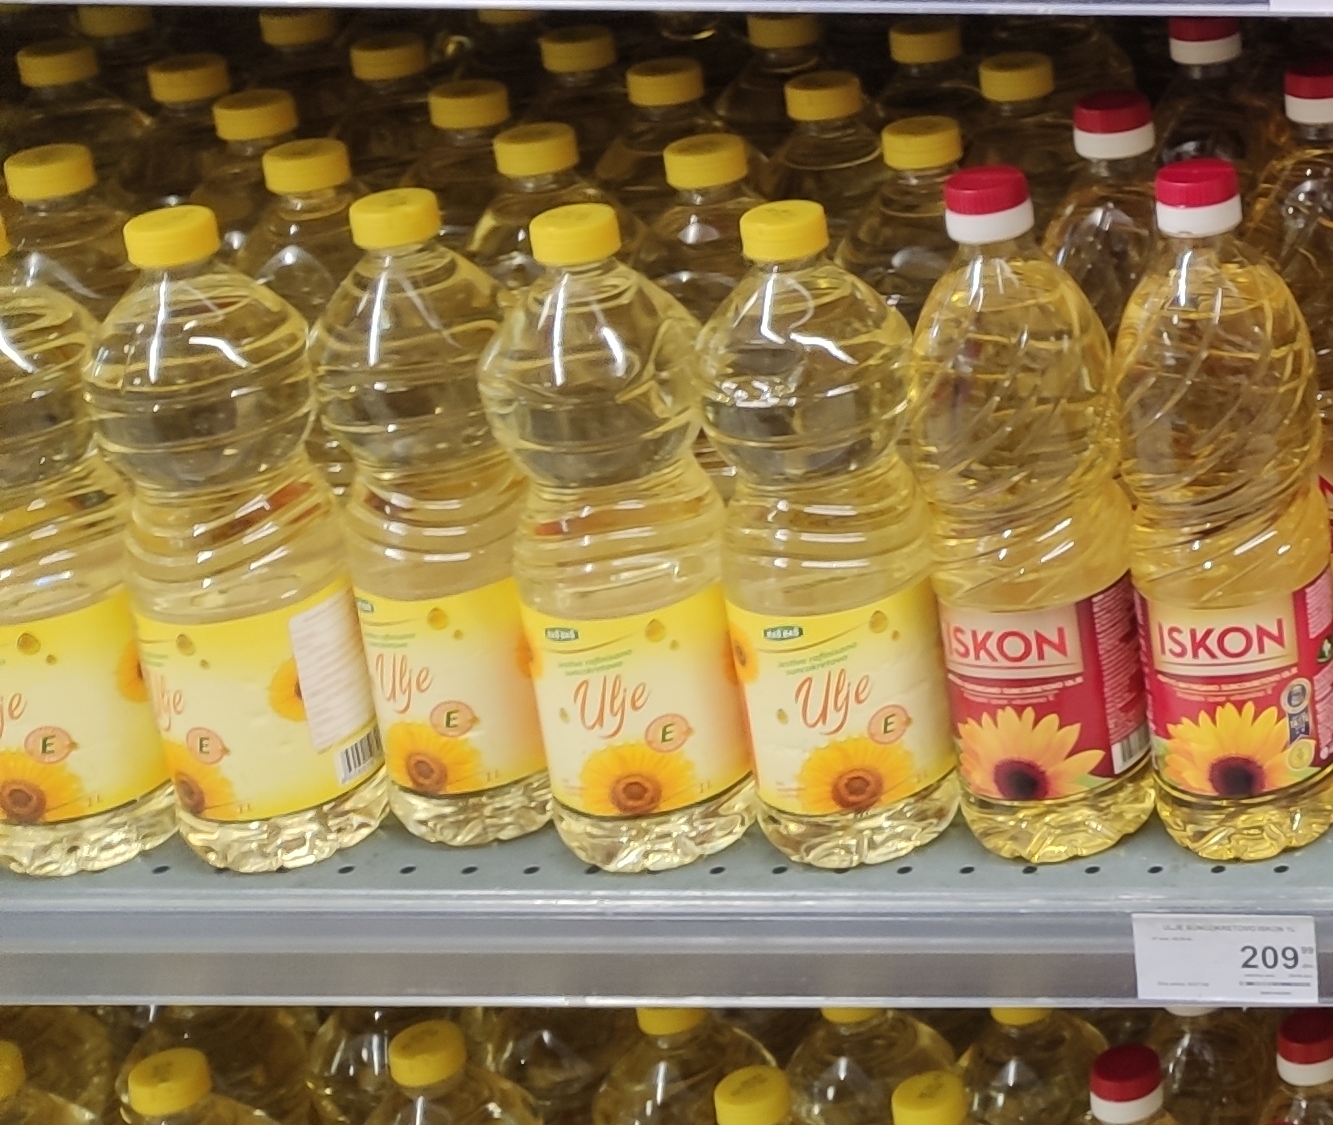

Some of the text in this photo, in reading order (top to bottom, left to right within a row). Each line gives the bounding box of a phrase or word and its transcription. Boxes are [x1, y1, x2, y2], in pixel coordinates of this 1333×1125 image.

[943, 625, 1069, 665] ISKON
[1158, 618, 1288, 660] ISKON
[375, 652, 434, 714] Ulje
[0, 692, 27, 738] je
[573, 673, 649, 739] Ulje
[795, 668, 872, 736] Ulje
[445, 710, 460, 729] E
[660, 723, 675, 743] E
[883, 713, 896, 735] E
[41, 735, 55, 755] E
[199, 736, 210, 755] E
[1240, 945, 1299, 969] 209
